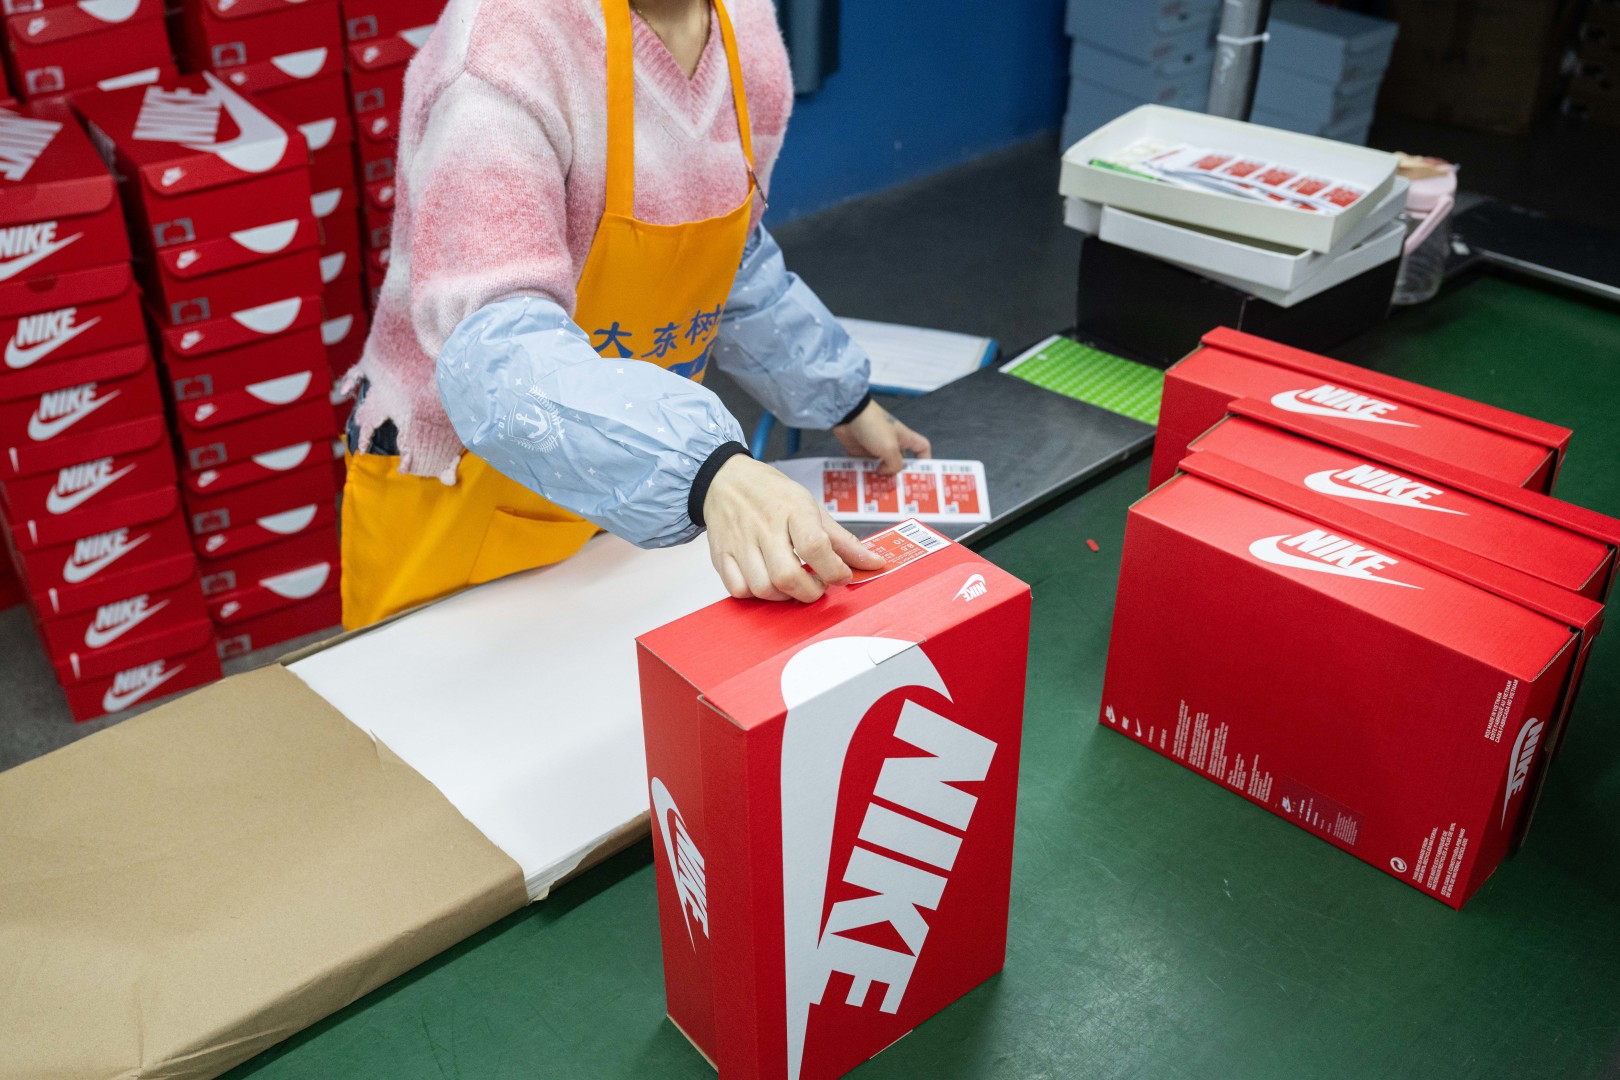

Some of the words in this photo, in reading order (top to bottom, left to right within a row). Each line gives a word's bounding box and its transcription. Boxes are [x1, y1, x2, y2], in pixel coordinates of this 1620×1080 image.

[16, 307, 77, 347] NIKE
[593, 304, 721, 358] 大东树
[38, 382, 98, 420] NIKE
[1298, 384, 1398, 419] NIKE
[57, 456, 114, 495] NIKE
[1333, 464, 1444, 505] NIKE
[73, 527, 129, 565] NIKE
[1282, 529, 1399, 575] NIKE
[962, 581, 988, 602] NIKE
[95, 593, 149, 630] NIKE
[113, 659, 166, 694] NIKE
[1508, 721, 1544, 800] NIKE
[806, 698, 998, 1015] NIKE
[675, 815, 710, 939] NIKE
